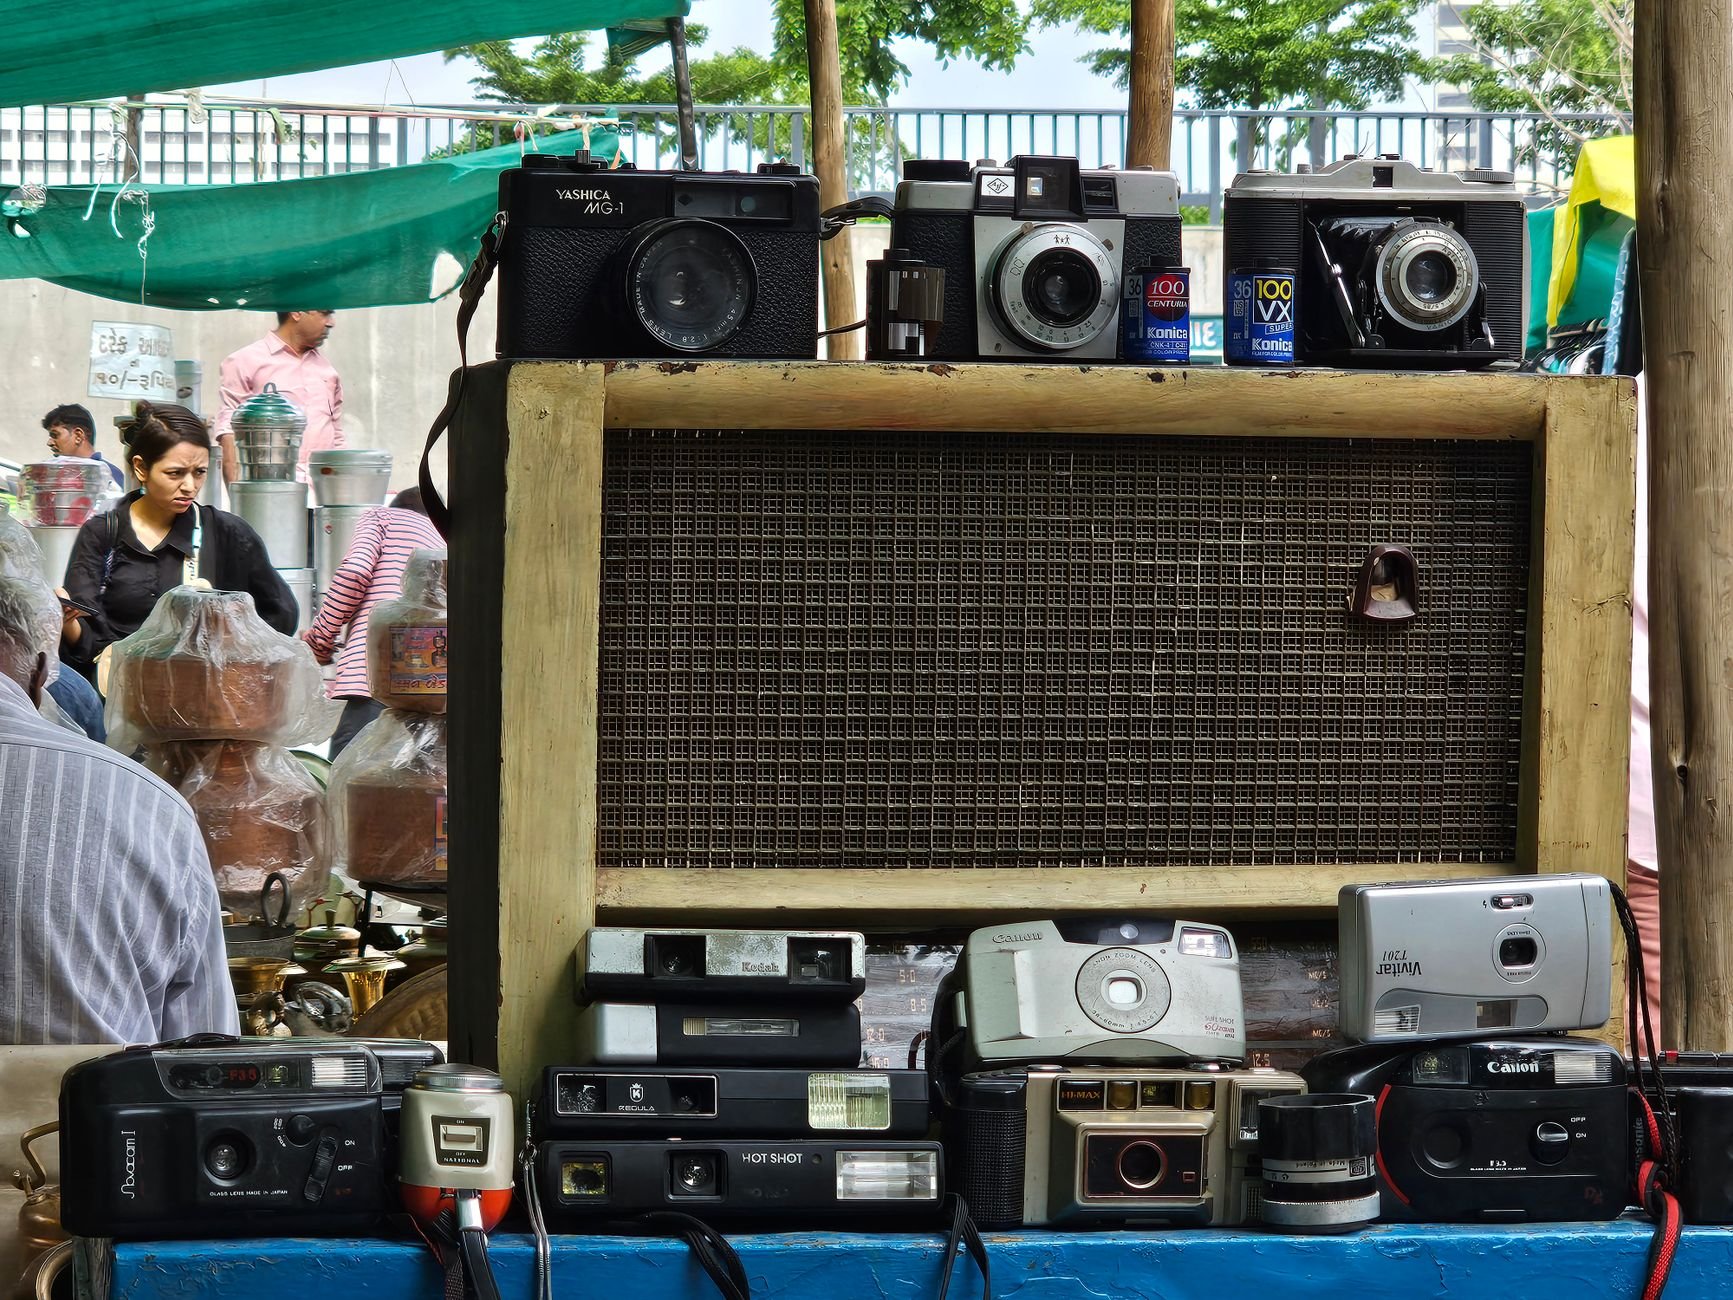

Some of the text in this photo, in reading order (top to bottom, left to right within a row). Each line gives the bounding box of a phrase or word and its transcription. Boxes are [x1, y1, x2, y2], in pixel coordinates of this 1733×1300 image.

[556, 189, 611, 200] YASHICA
[584, 202, 623, 214] MG-1
[1128, 280, 1141, 296] 36
[1151, 281, 1184, 295] 100
[1234, 281, 1251, 299] 36
[1257, 280, 1292, 300] 100
[1147, 300, 1187, 308] CENTURIA
[1257, 300, 1291, 322] VX
[648, 319, 672, 339] LENS
[1147, 326, 1188, 339] Konica
[1269, 323, 1293, 332] SUPER
[1252, 338, 1292, 351] Konica
[992, 932, 1043, 943] Canon
[1114, 951, 1136, 959] ZOOM
[1139, 958, 1156, 973] LENS
[1383, 950, 1407, 961] T201
[742, 961, 780, 972] Kodak
[1376, 962, 1422, 977] Vivitar
[1487, 1060, 1539, 1073] Canon
[742, 1153, 803, 1163] HOT SHOT
